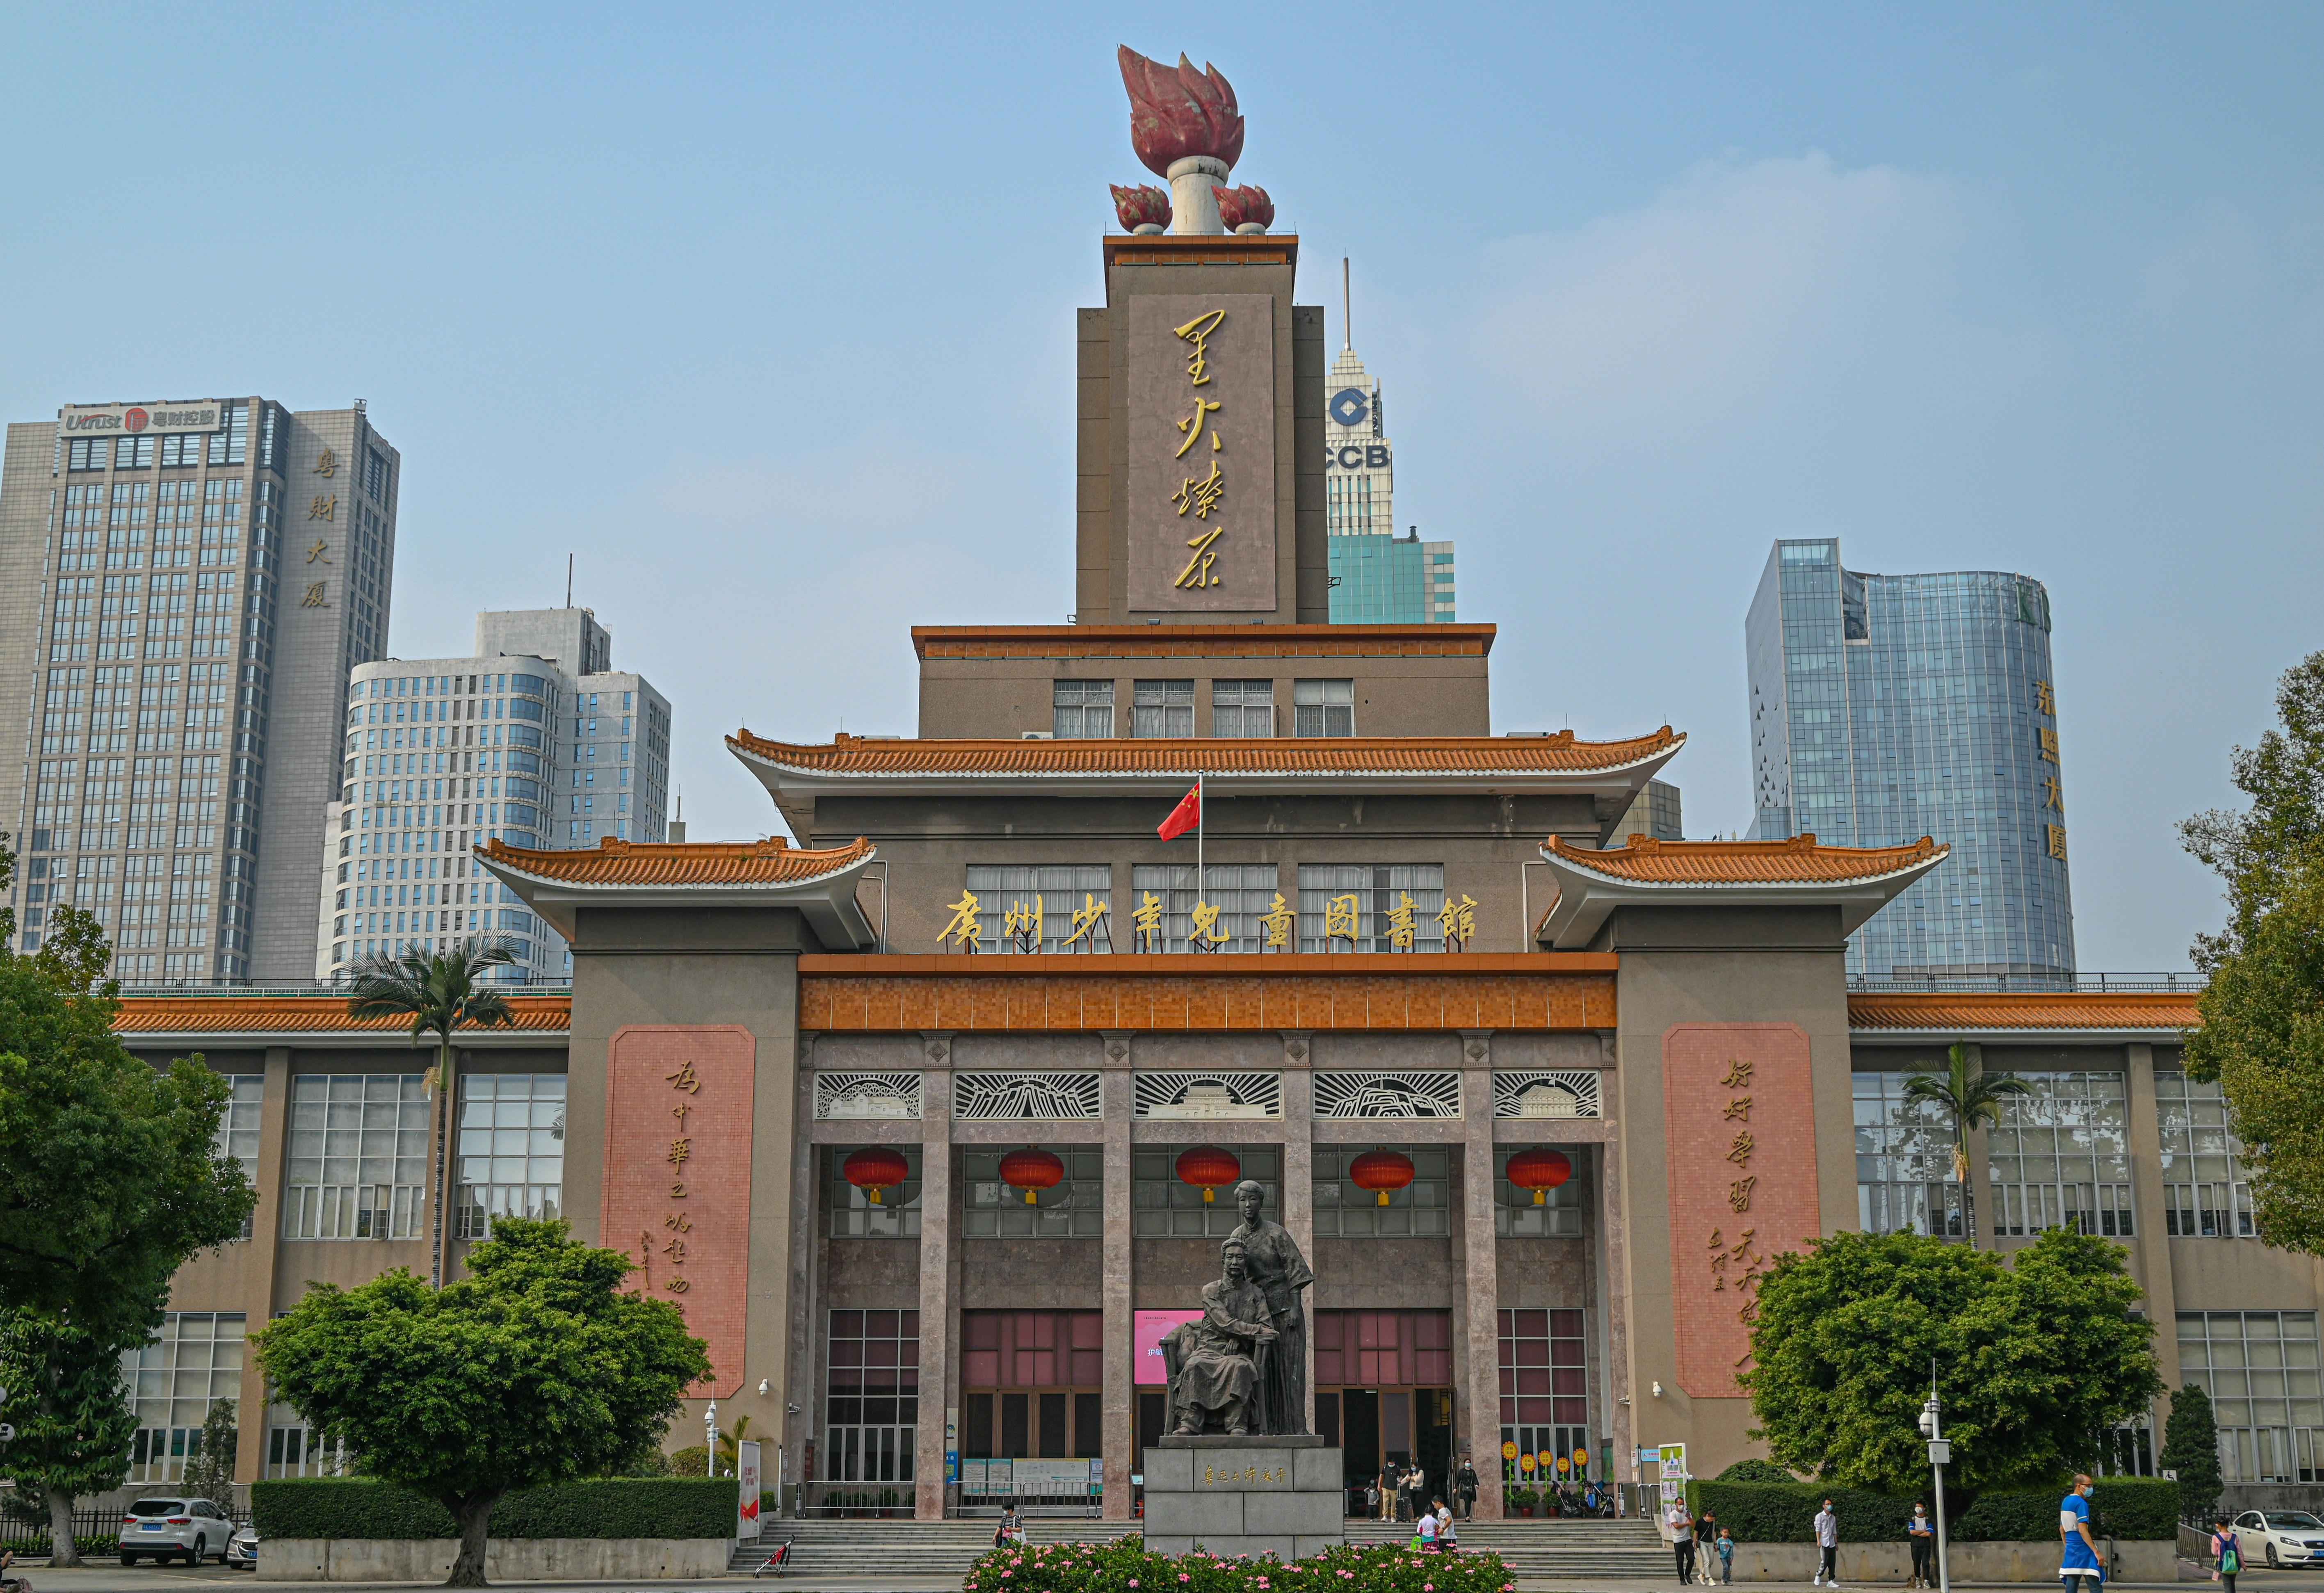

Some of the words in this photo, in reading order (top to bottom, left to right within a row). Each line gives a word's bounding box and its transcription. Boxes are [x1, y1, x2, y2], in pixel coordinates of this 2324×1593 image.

[65, 413, 122, 430] Utrust
[151, 409, 215, 427] 粤财控股
[1172, 309, 1226, 588] 星火燎原
[2036, 680, 2067, 861] 东照大厦
